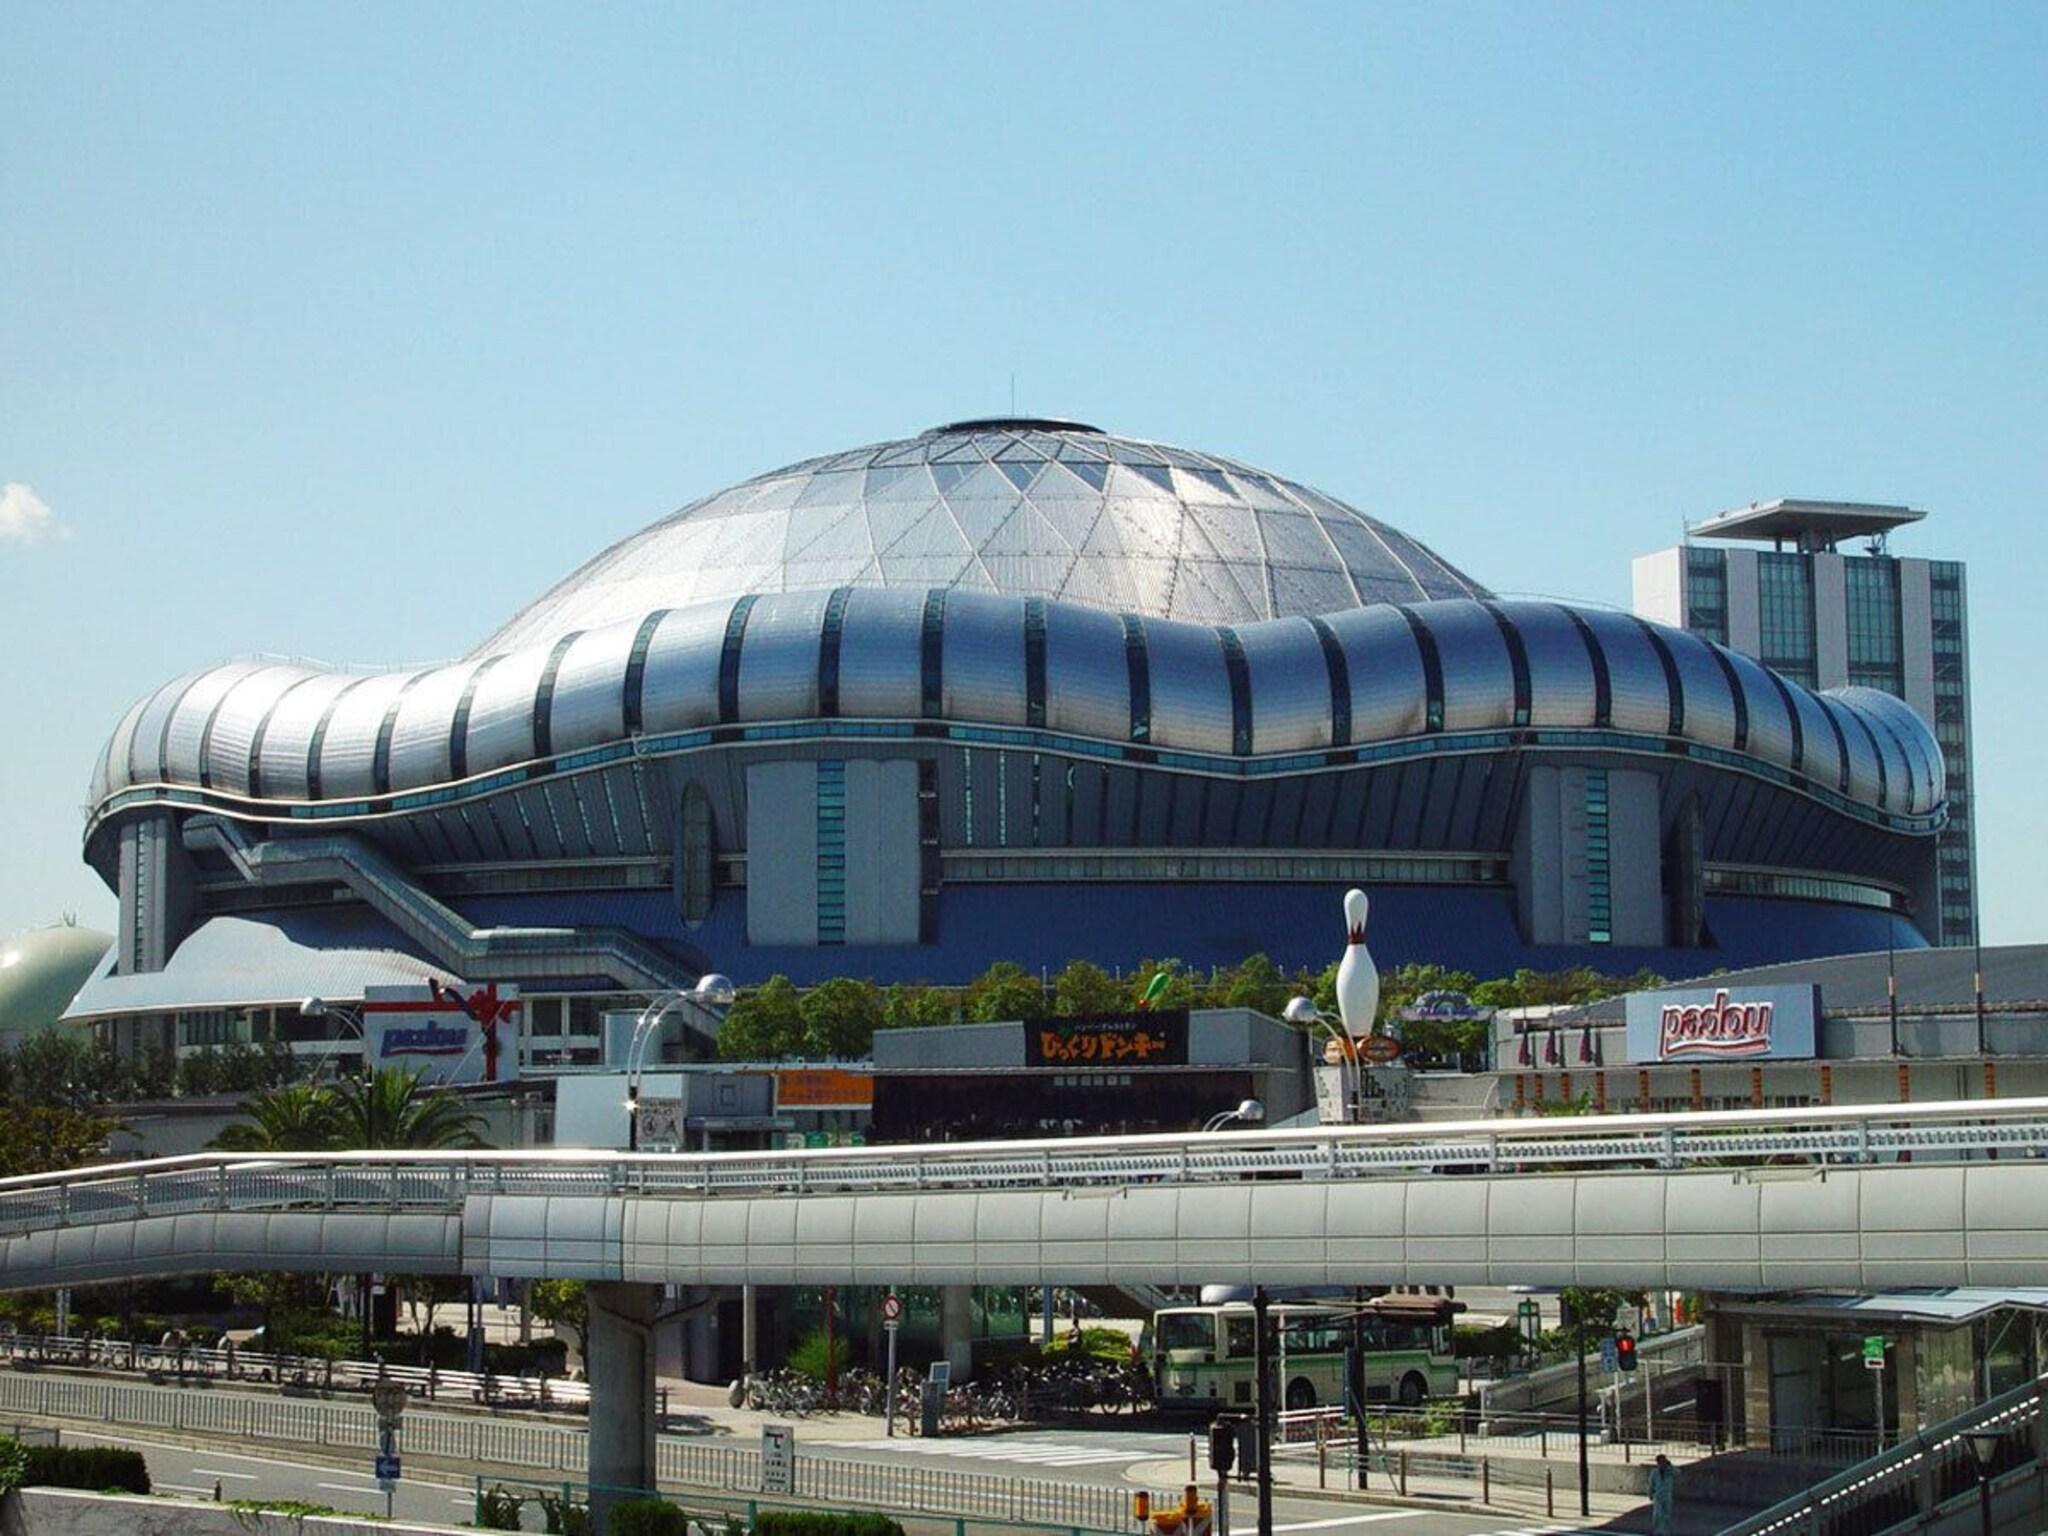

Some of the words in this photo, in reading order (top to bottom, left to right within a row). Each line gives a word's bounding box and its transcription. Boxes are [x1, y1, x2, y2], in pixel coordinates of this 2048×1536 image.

[1040, 1031, 1166, 1060] びっくりドンキー
[1658, 988, 1773, 1060] padou
